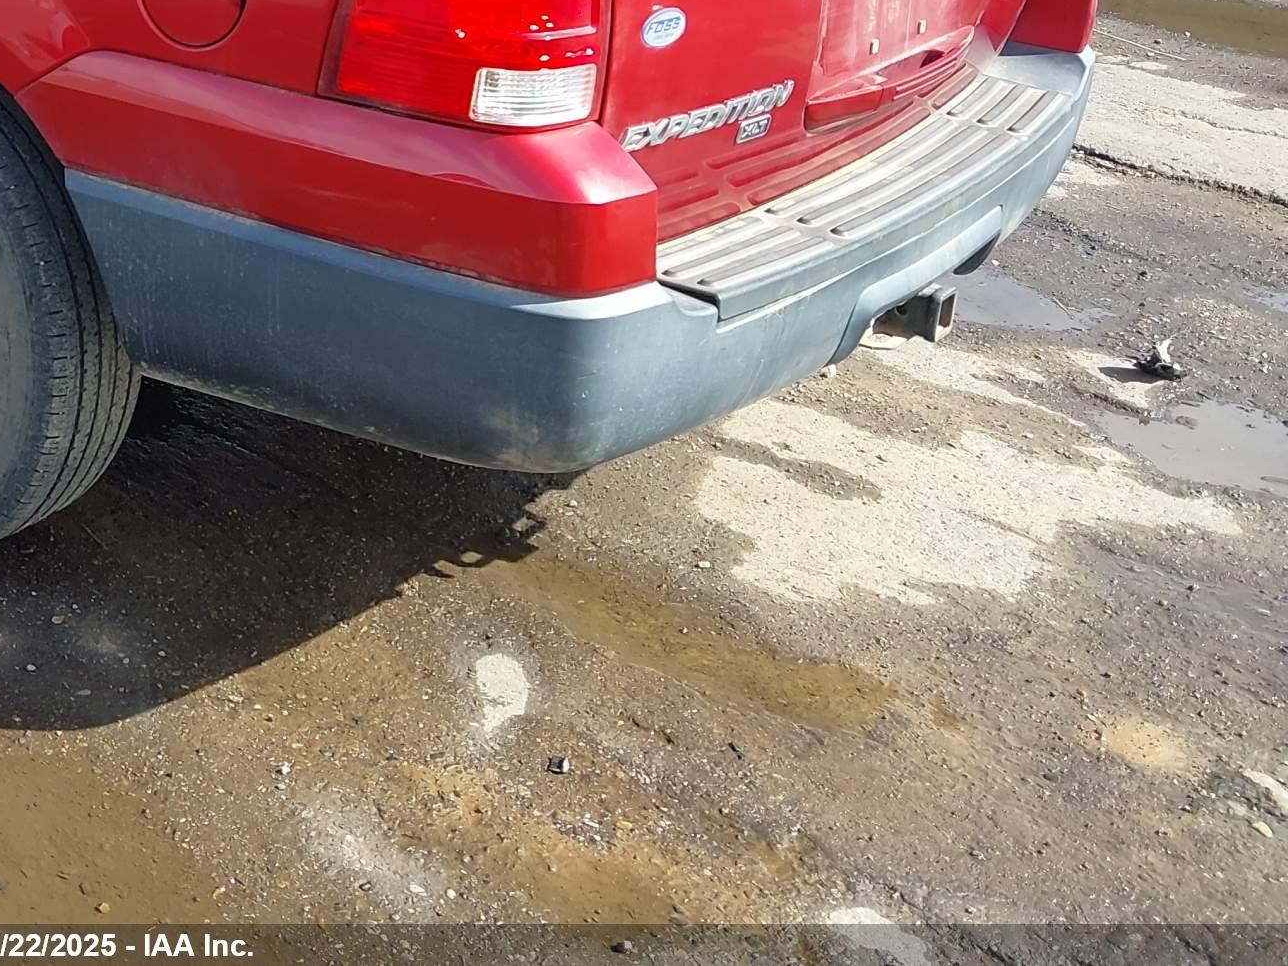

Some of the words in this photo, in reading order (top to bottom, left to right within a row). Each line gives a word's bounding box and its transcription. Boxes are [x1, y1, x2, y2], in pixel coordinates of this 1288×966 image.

[645, 16, 682, 35] FOSS
[620, 79, 795, 153] EXPEDITION
[741, 118, 770, 138] XLT
